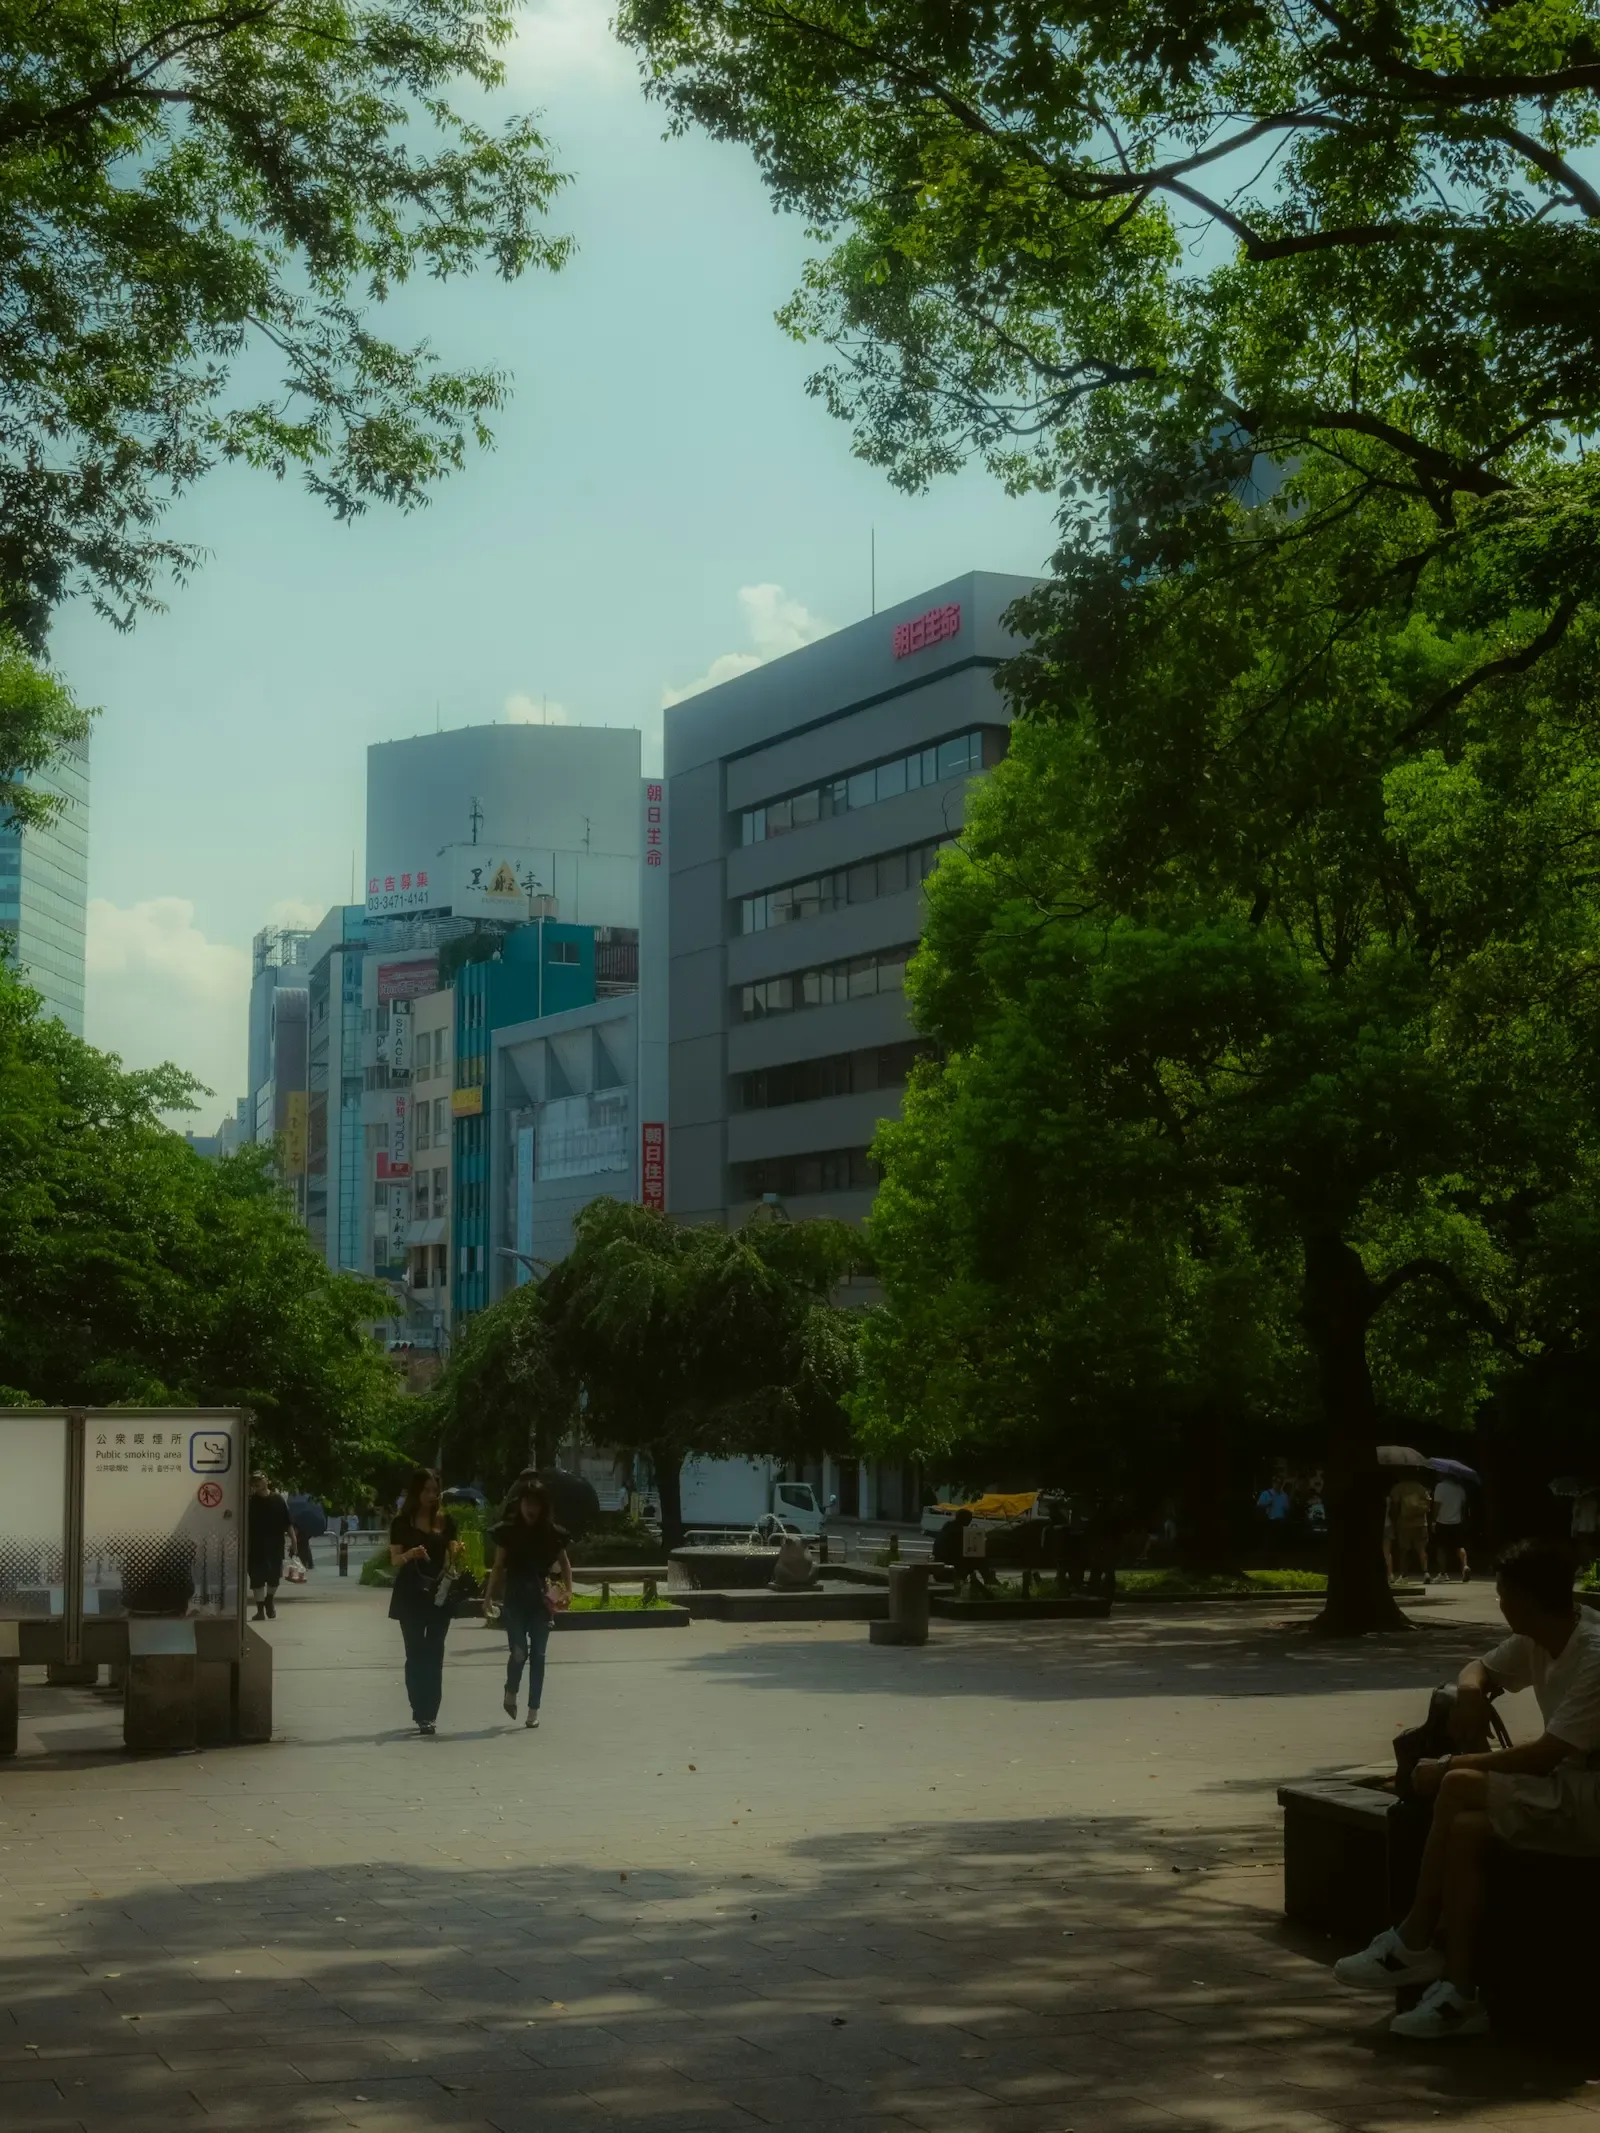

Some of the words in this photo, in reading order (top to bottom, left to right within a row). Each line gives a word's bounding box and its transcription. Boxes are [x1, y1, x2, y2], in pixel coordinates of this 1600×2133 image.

[893, 603, 961, 660] 朝日生命
[646, 784, 664, 867] 朝日生命
[368, 871, 429, 894] 広告募集
[368, 890, 429, 911] 03-3471-4141
[395, 1018, 404, 1066] SPACE
[644, 1127, 663, 1198] 朝日住宅
[95, 1450, 121, 1459] Public
[124, 1450, 160, 1461] smoking
[96, 1433, 183, 1445] 公衆喫煙所
